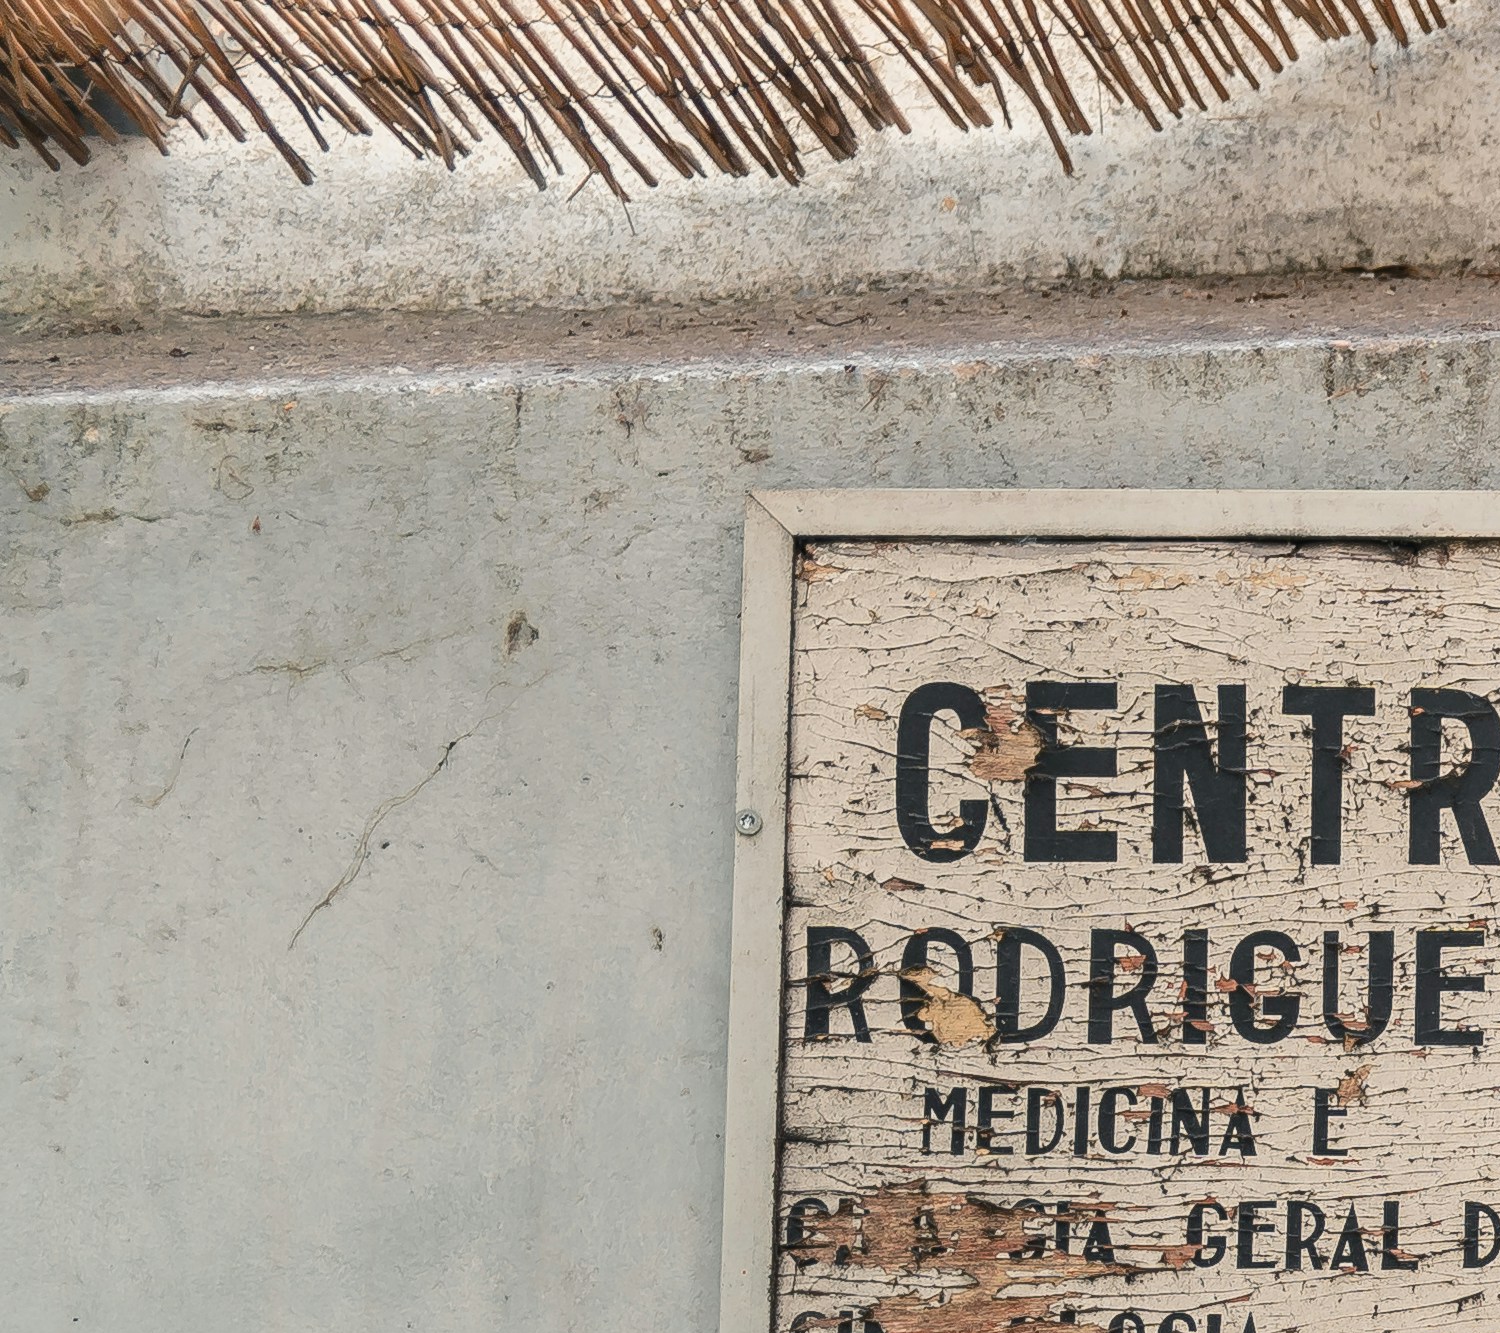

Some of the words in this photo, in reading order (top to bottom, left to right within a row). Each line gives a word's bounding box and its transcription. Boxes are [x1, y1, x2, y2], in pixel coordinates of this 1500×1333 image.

[924, 1086, 1257, 1157] MEDICINA
[1313, 1088, 1350, 1157] E
[1188, 1199, 1419, 1272] GERAL
